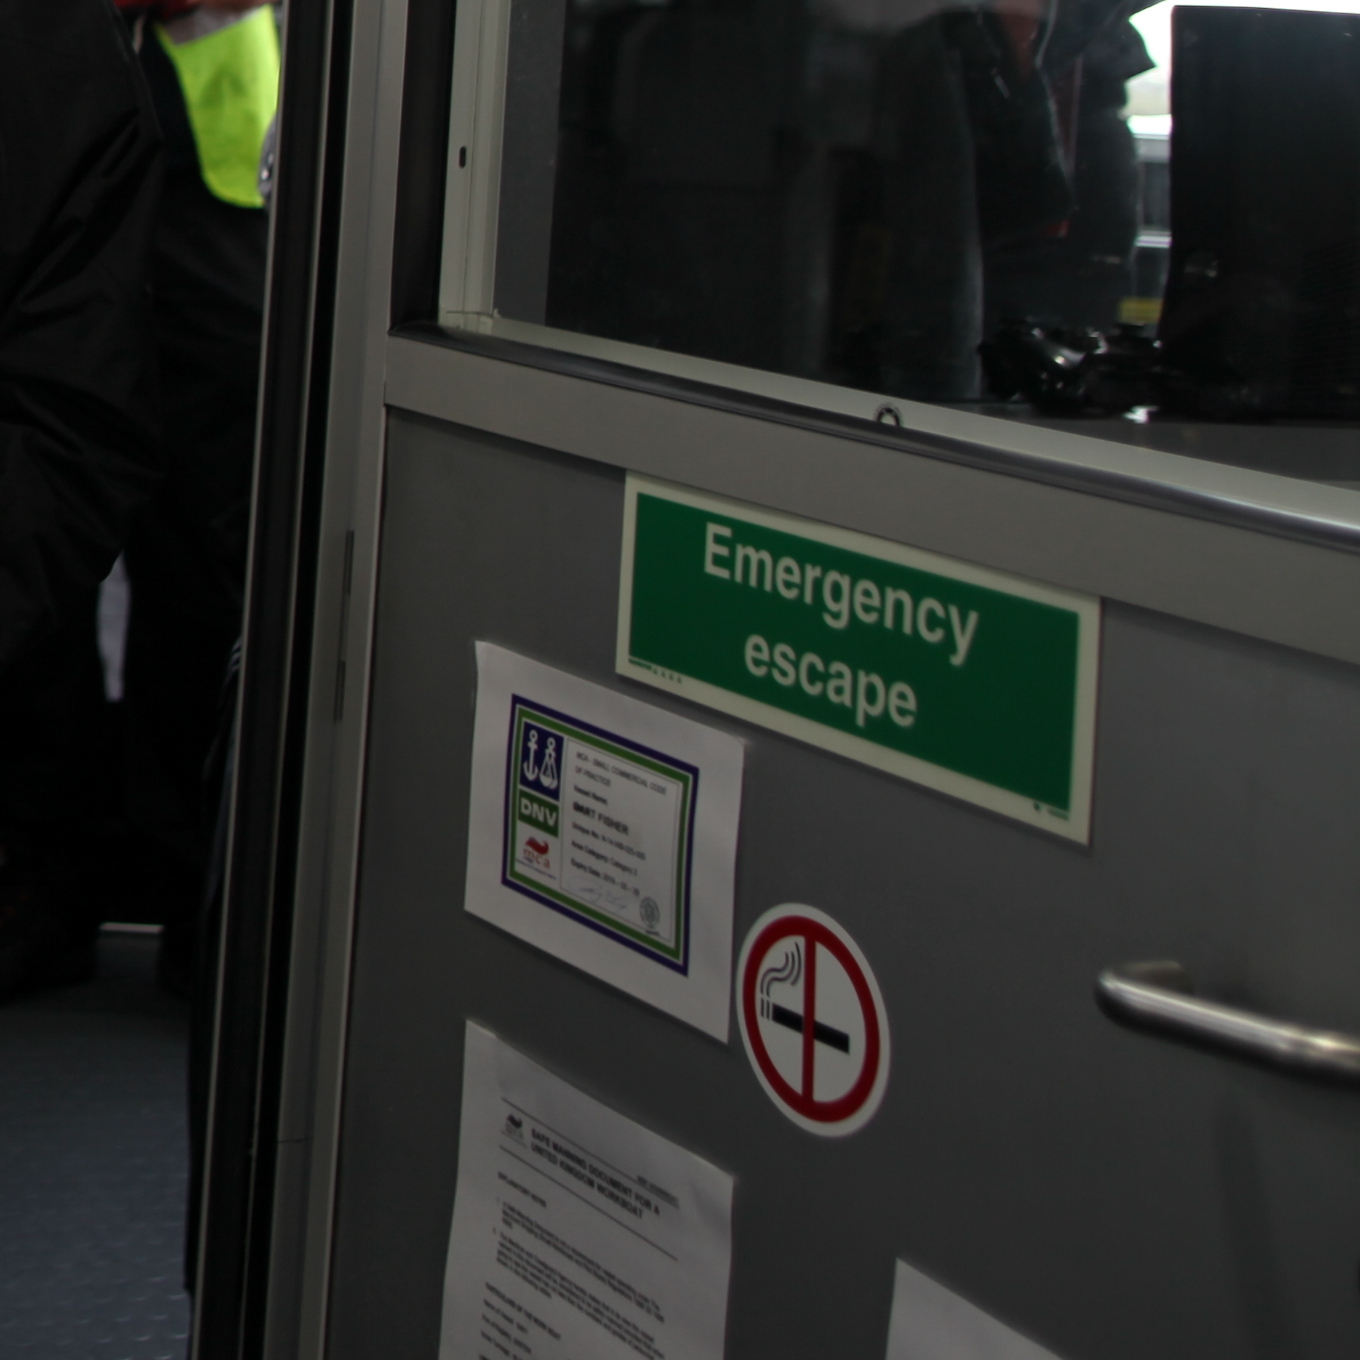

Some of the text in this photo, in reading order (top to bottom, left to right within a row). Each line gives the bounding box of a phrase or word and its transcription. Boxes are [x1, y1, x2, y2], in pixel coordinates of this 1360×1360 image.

[704, 522, 979, 668] Emergency
[744, 633, 918, 727] escape
[521, 798, 557, 828] DNV
